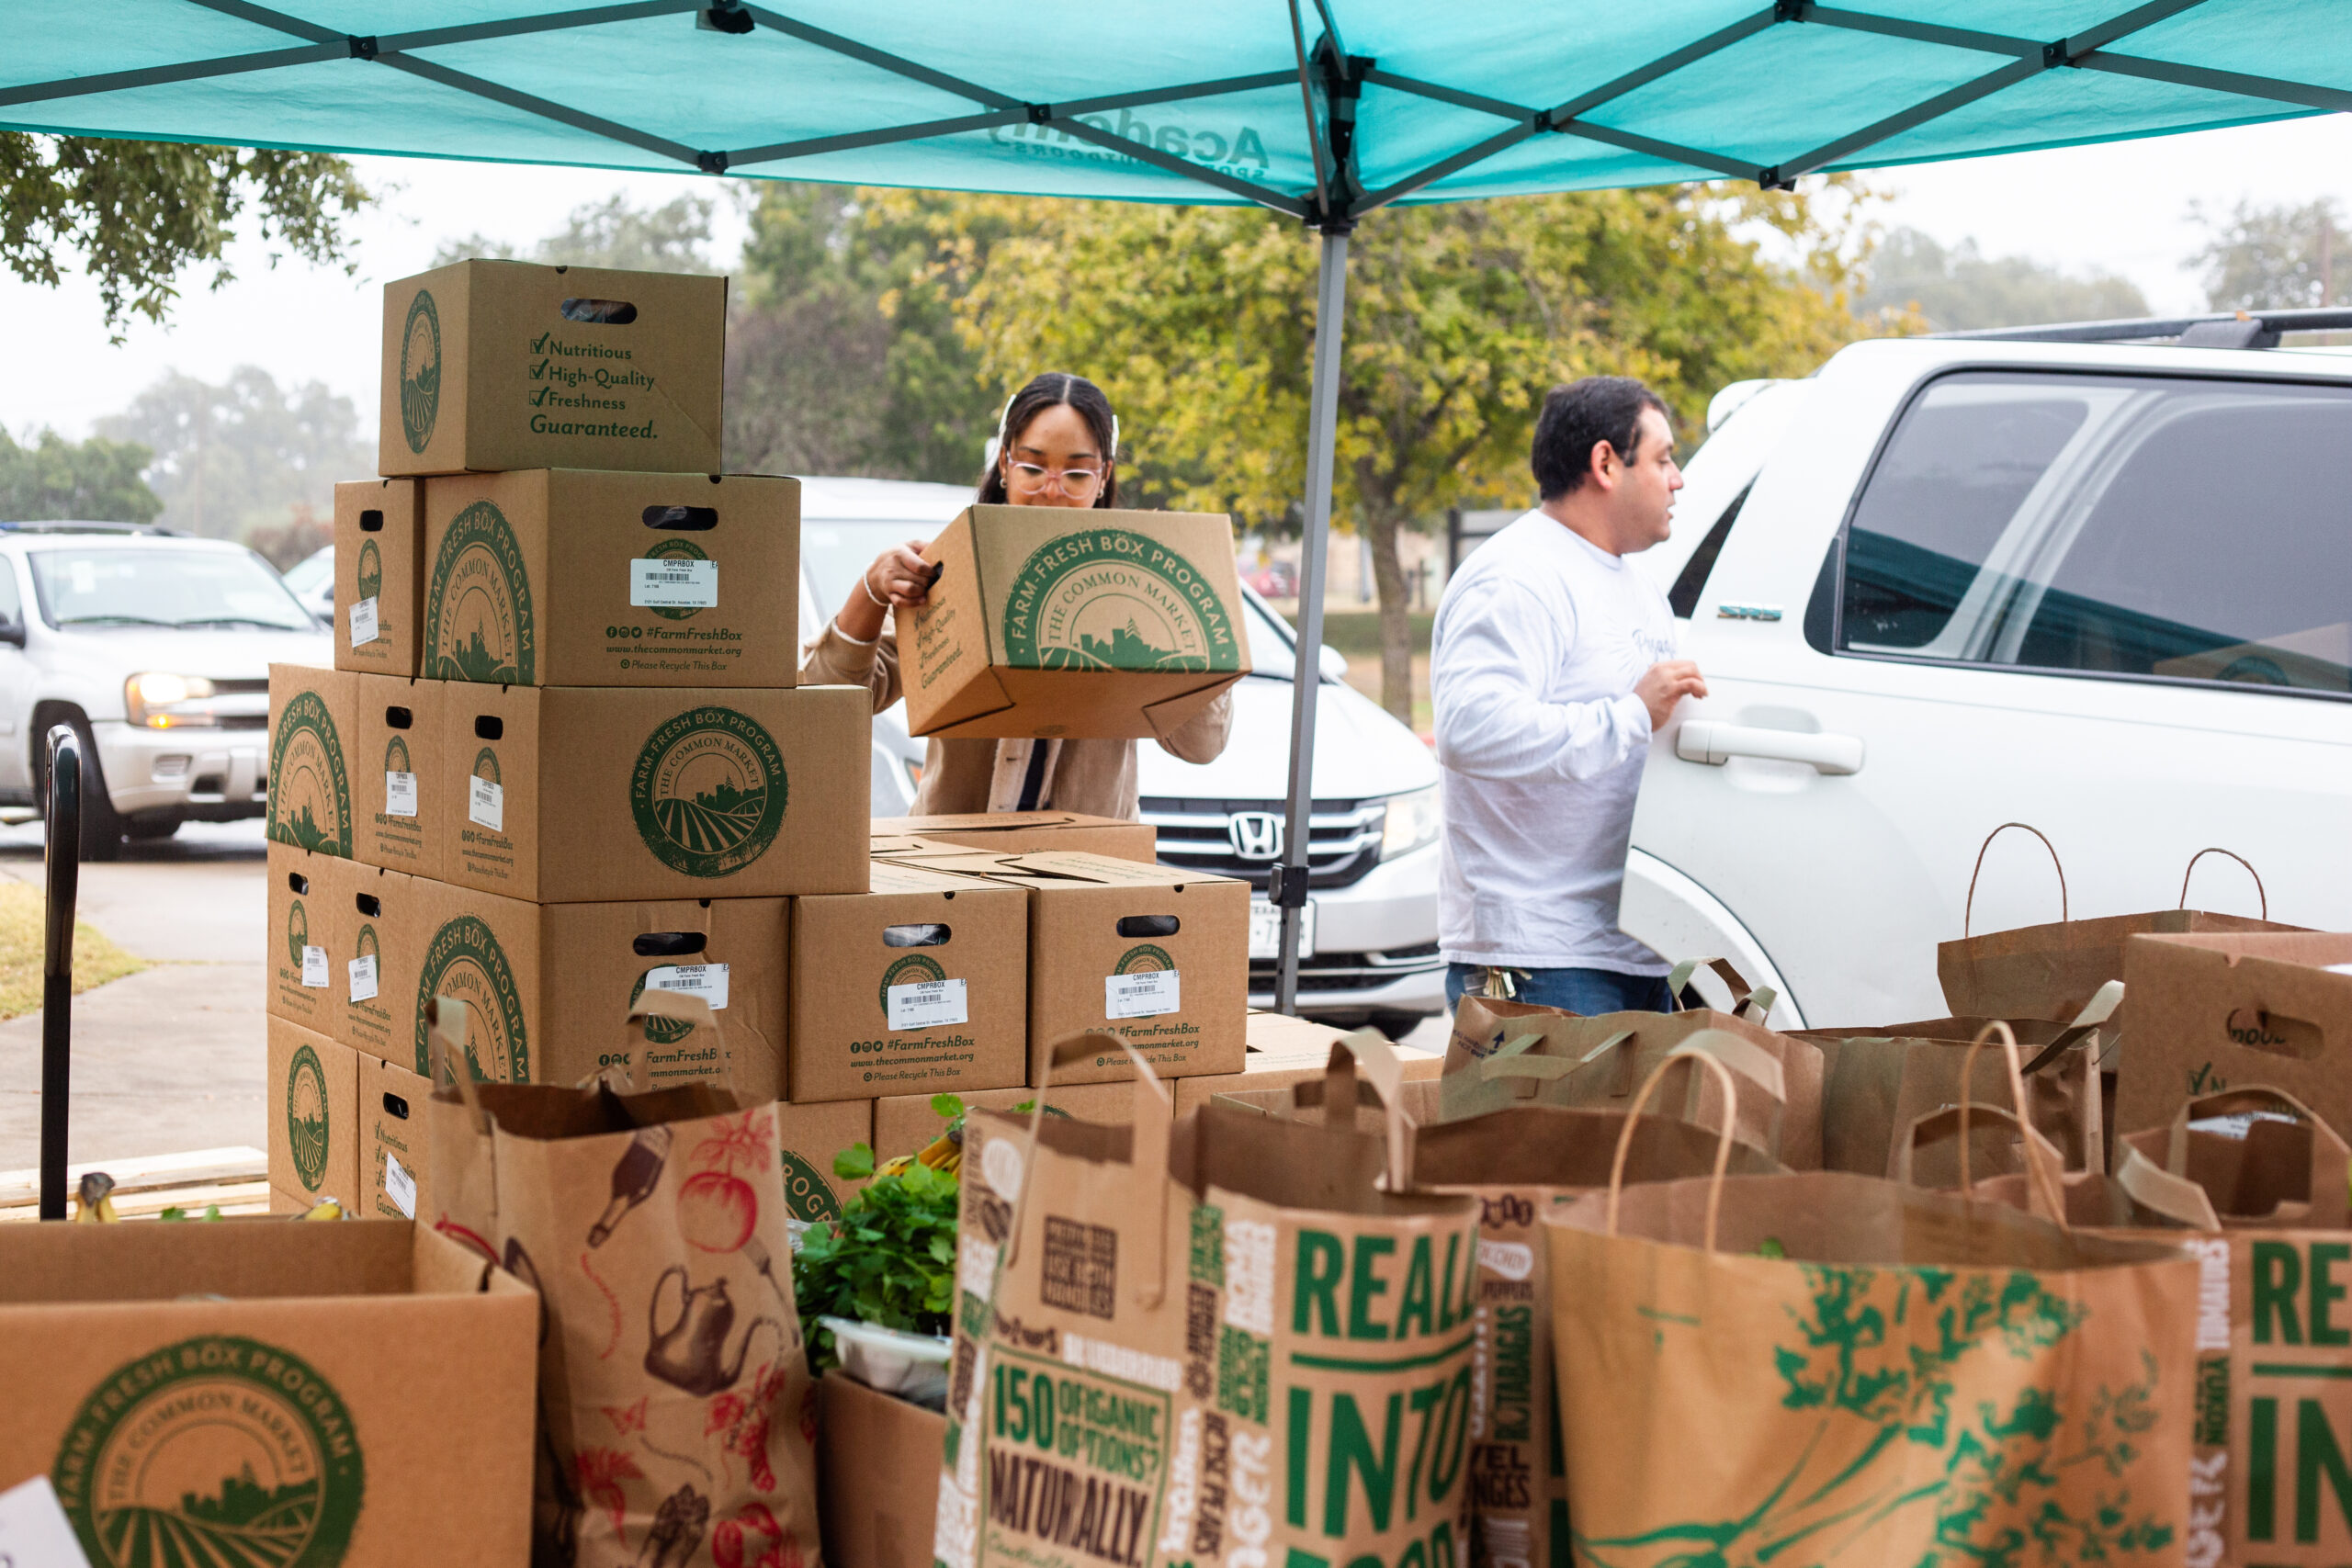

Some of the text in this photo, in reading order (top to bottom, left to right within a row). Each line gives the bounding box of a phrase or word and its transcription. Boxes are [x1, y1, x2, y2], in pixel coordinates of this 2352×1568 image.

[549, 340, 632, 360] Nutritious
[548, 367, 654, 390] High-Quality
[548, 392, 626, 410] Freshness
[529, 414, 658, 439] Guaranteed.
[474, 511, 496, 536] BOX
[497, 525, 531, 650] PROGRAM
[1012, 536, 1229, 646] FARM-FRESH BOX PROGRAM
[451, 558, 490, 597] COMMON
[489, 570, 513, 658] MARKET
[1048, 571, 1196, 650] THE COMMON MARKET
[647, 627, 742, 640] #FarmFreshBox
[606, 645, 741, 657] www.thecommonmarket.org
[632, 660, 727, 671] Please Recycle This Box
[304, 699, 321, 723] BOX
[322, 718, 349, 829] PROGRAM
[636, 713, 781, 798] FARM-FRESH BOX PROGRAM
[661, 738, 759, 796] THE COMMON MARKET
[676, 965, 707, 974] CMPRBOX
[922, 958, 944, 979] PROGRA
[444, 972, 481, 998] OMMON
[917, 981, 945, 989] CMPRBOX
[464, 925, 488, 954] BOX
[488, 947, 526, 1077] PROGRAM
[1119, 1023, 1200, 1037] #FarmFreshBox
[888, 1036, 975, 1051] #FarmFreshBox
[851, 1053, 974, 1067] www.thecommonmarket.org
[1106, 1057, 1129, 1066] Please
[1158, 1055, 1170, 1064] This
[1174, 1054, 1186, 1063] Box
[874, 1067, 961, 1081] Please Recycle This Box
[380, 1129, 408, 1153] Nutritious
[182, 1343, 242, 1370] BOX
[250, 1351, 353, 1459] PROGRAM
[995, 1363, 1159, 1450] 150 ORGANIC
[129, 1392, 233, 1449] COMMON
[242, 1398, 306, 1472] MARKET
[1287, 1364, 1472, 1539] INTO
